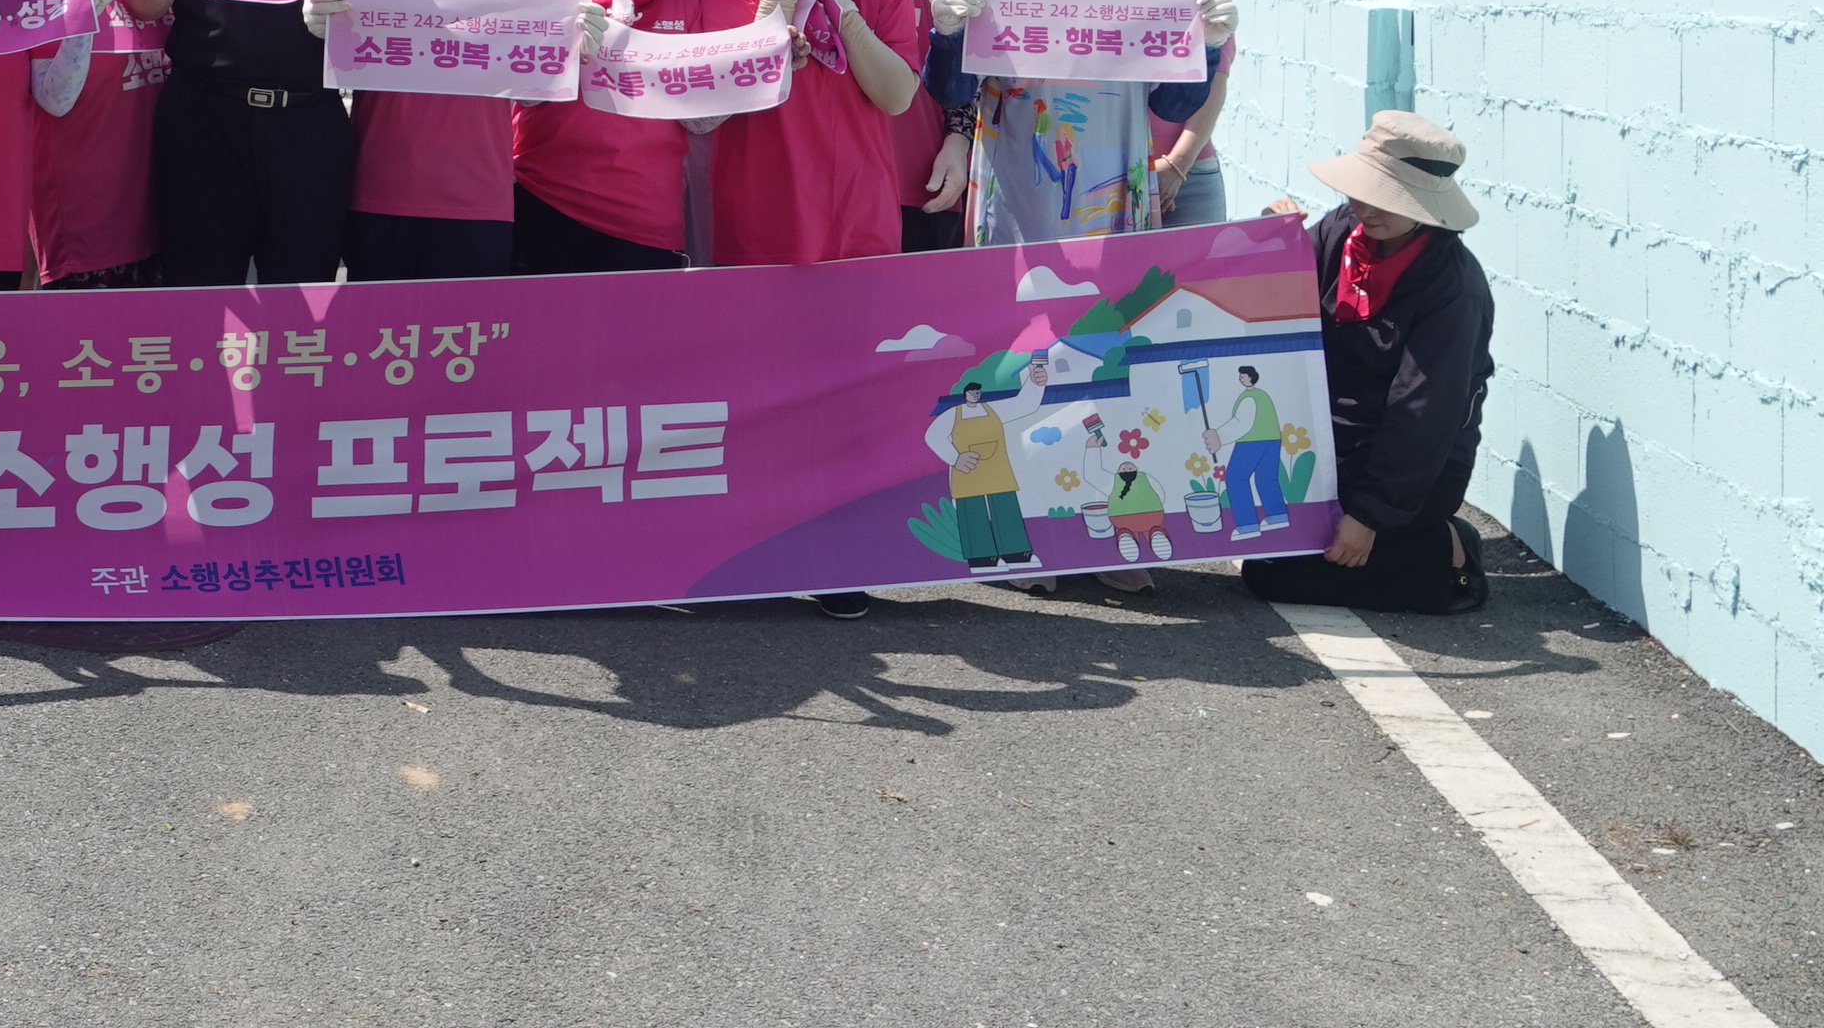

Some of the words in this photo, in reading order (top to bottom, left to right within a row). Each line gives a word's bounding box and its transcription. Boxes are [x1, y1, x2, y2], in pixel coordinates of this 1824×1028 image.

[360, 11, 407, 29] 진도군
[413, 13, 444, 29] 242
[449, 16, 565, 37] 소행성프로젝트
[999, 0, 1045, 18] 진도군
[1050, 3, 1078, 18] 242
[1084, 4, 1193, 23] 소행성프로젝트
[597, 45, 639, 62] 진도군
[644, 51, 672, 63] 242
[676, 34, 778, 59] 소행성프로젝트
[311, 401, 729, 519] 프로젝트
[91, 566, 149, 594] 주관
[161, 552, 406, 593] 소행성추진위원회
